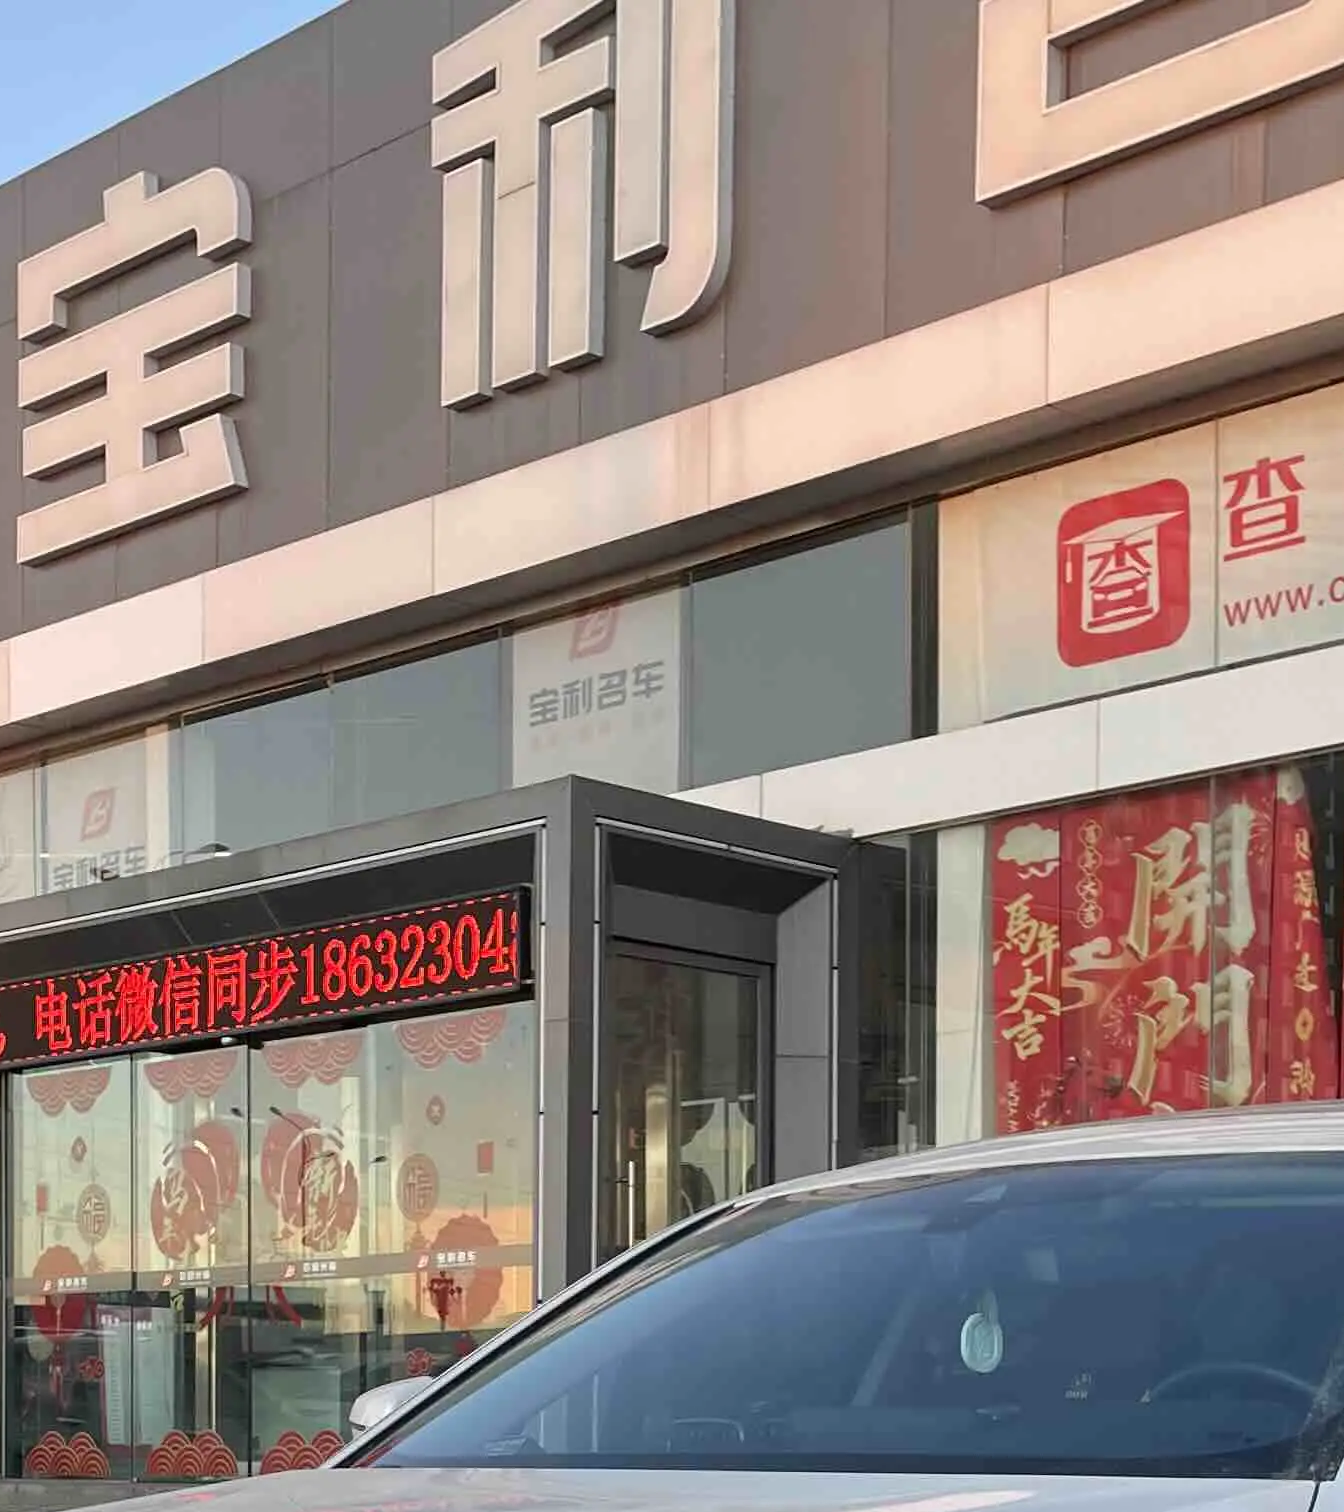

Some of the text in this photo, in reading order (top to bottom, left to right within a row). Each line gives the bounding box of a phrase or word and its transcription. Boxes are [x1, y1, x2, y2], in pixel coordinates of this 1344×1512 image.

[529, 660, 665, 727] 宝利名车
[1128, 804, 1257, 1112] 開門
